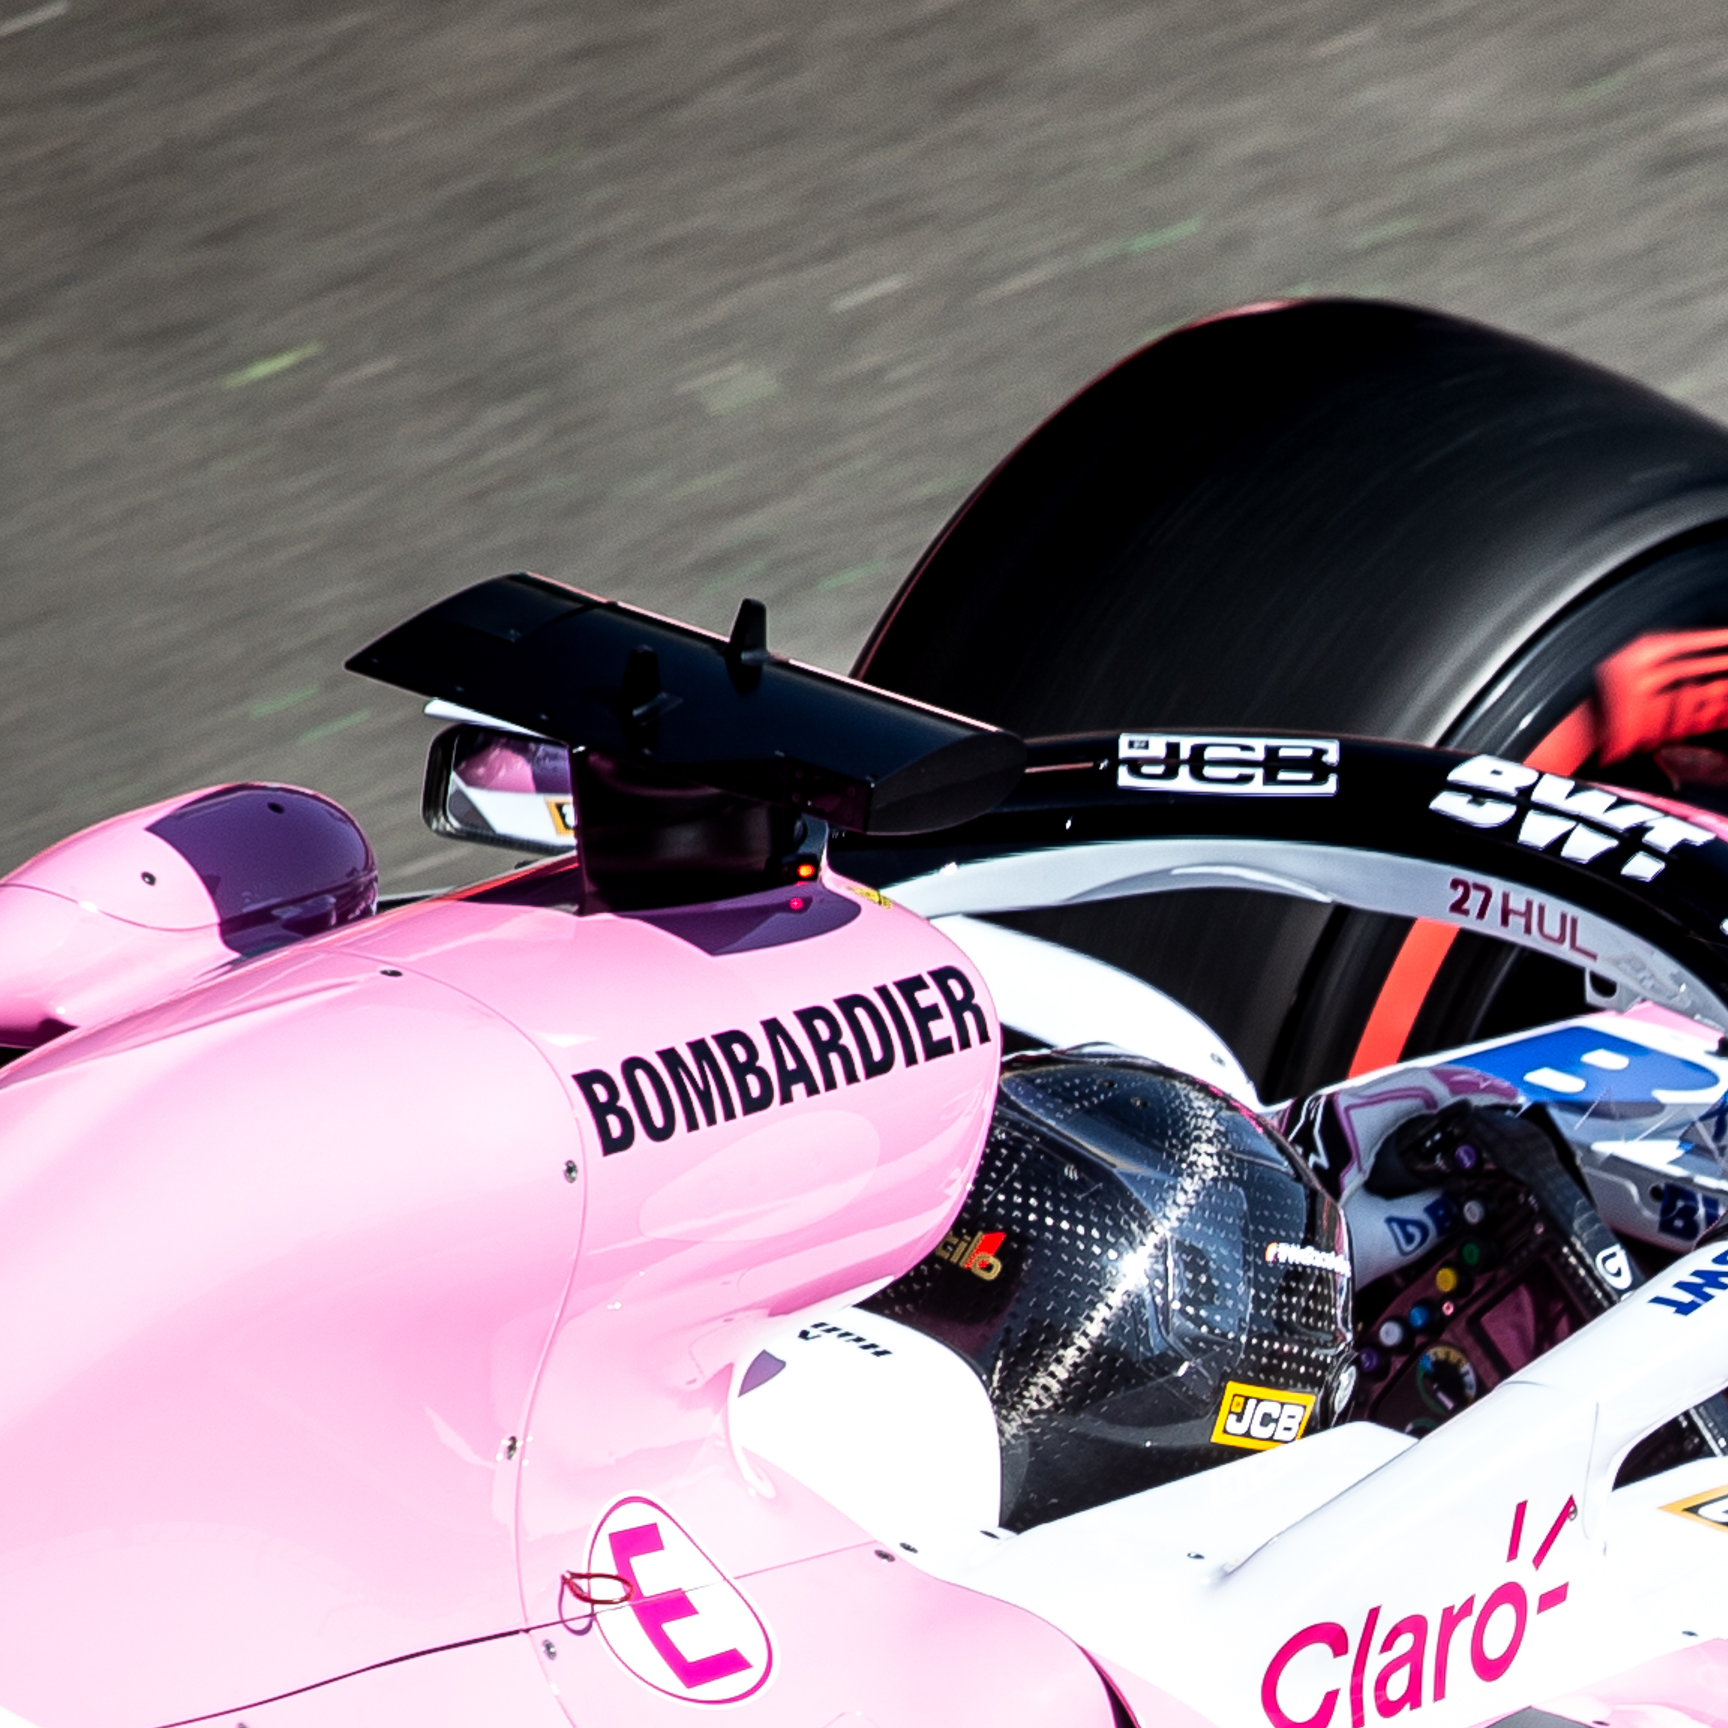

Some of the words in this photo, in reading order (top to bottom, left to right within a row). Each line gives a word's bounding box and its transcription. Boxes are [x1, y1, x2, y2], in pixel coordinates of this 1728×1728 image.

[1126, 740, 1330, 786] JCB
[1429, 753, 1717, 882] BWT
[1449, 877, 1493, 921] 27
[1500, 890, 1598, 962] HUL
[573, 965, 991, 1157] BOMBARDIER
[1225, 1398, 1305, 1441] JCB
[608, 1522, 753, 1690] E
